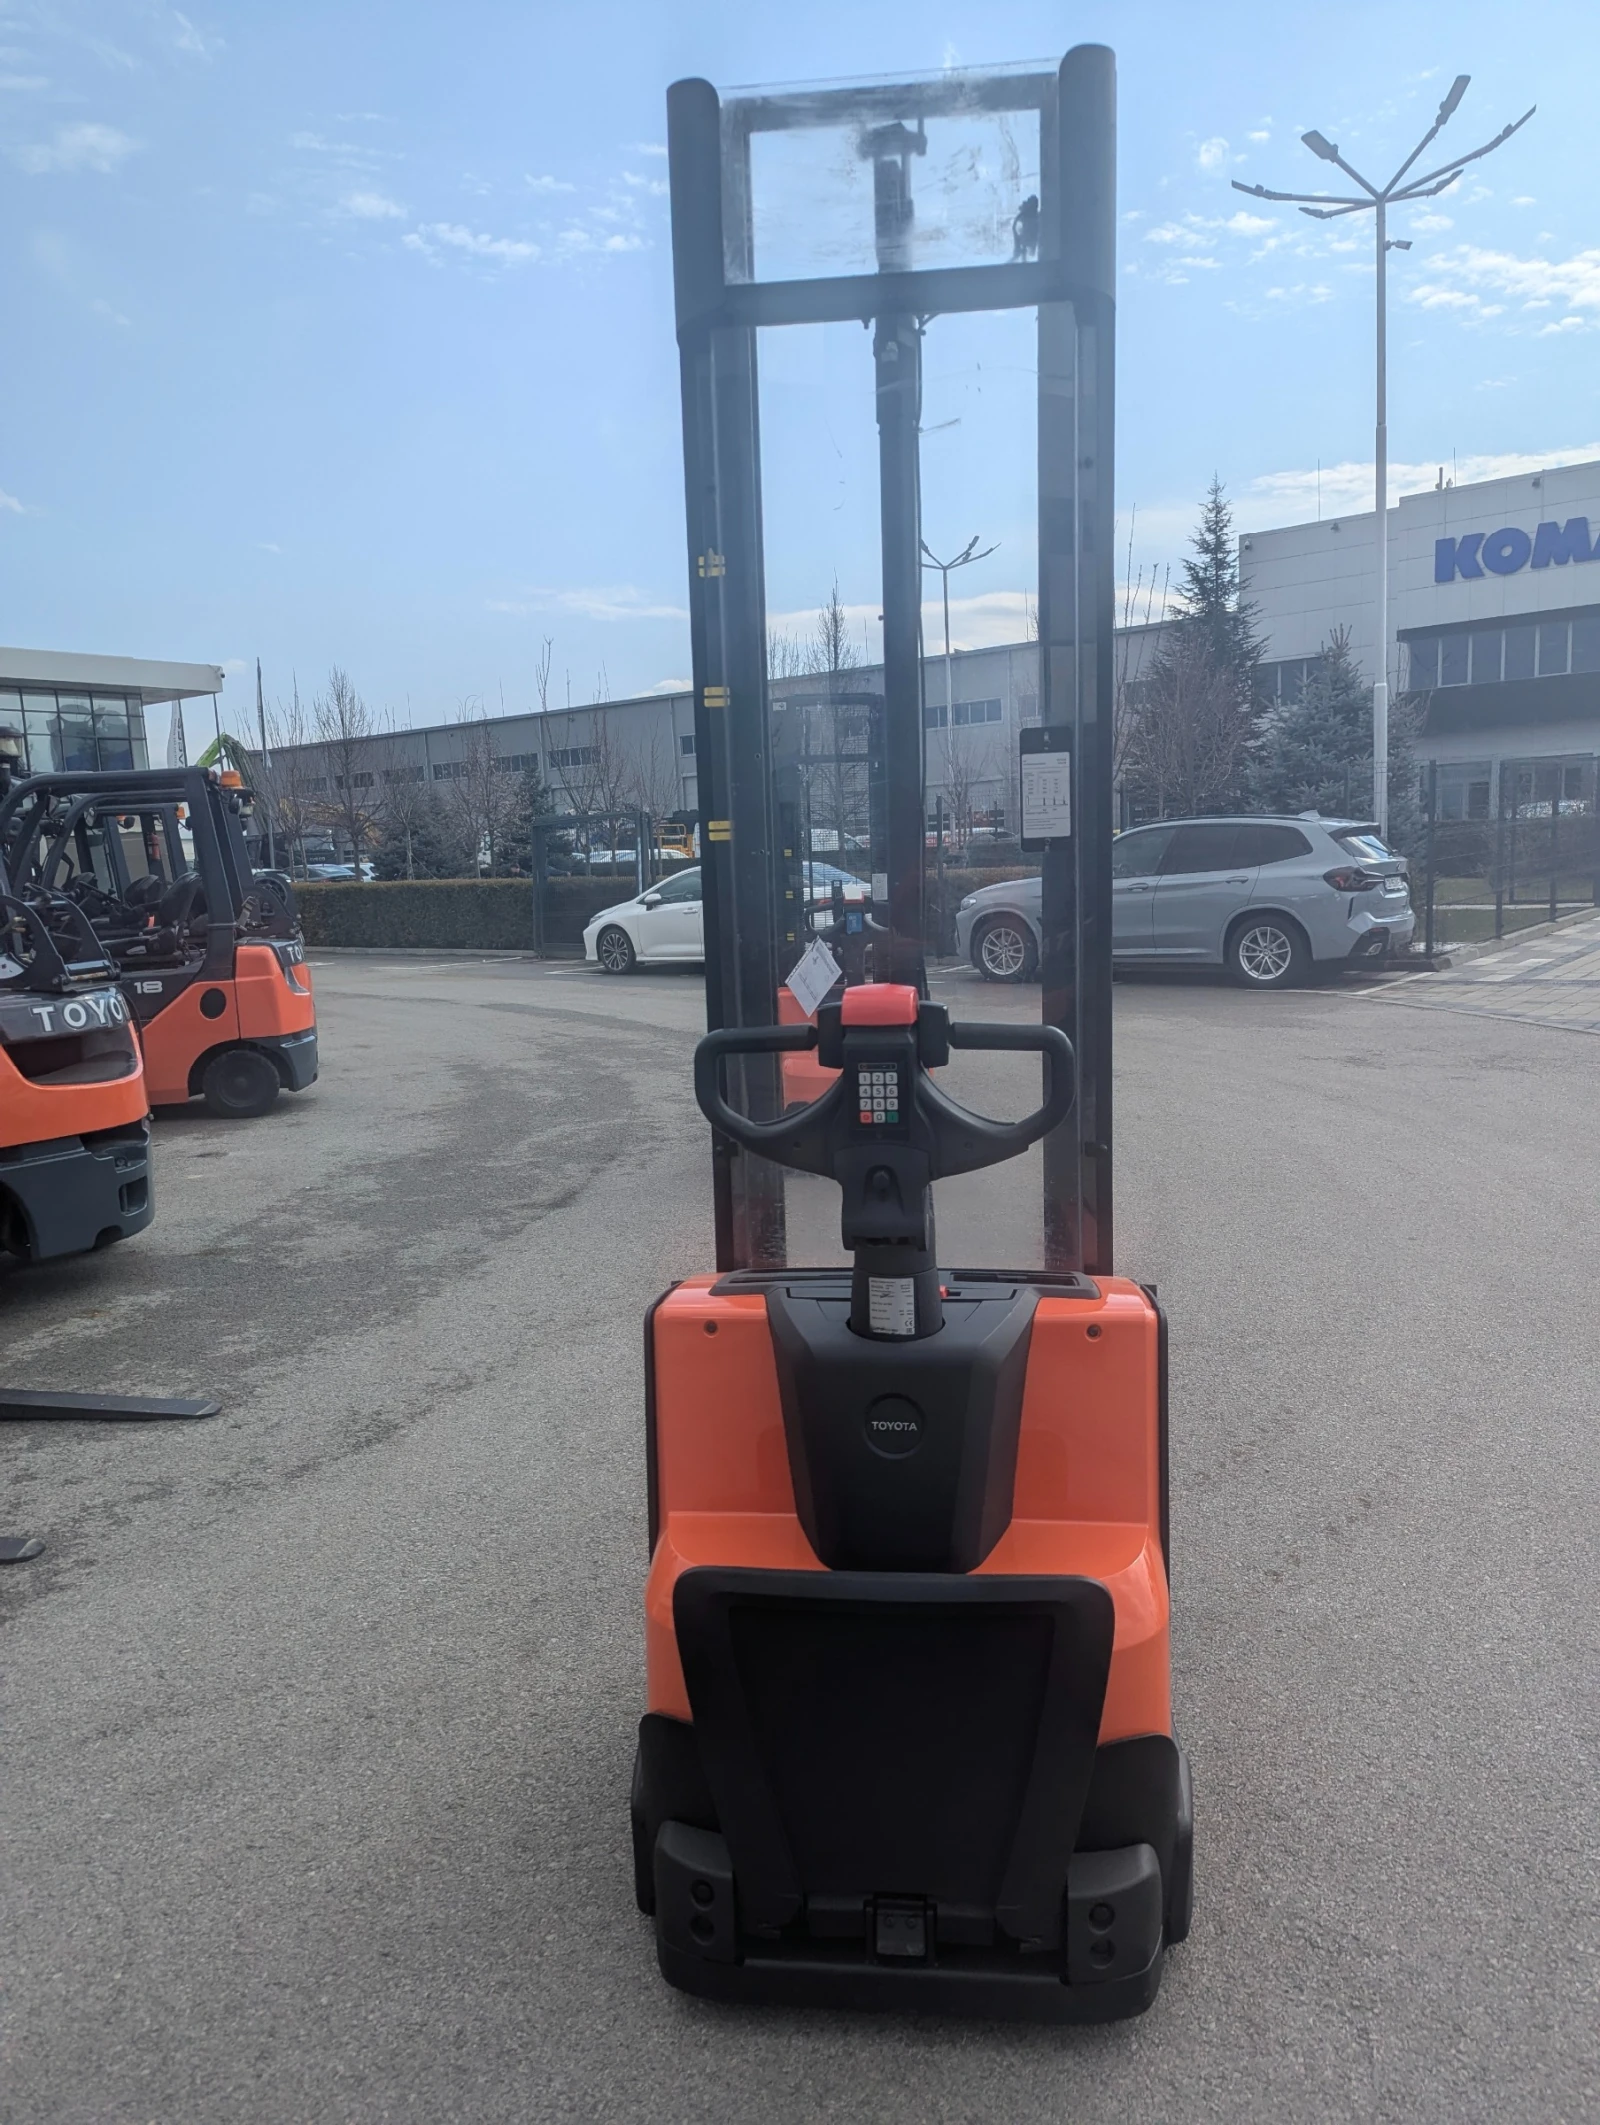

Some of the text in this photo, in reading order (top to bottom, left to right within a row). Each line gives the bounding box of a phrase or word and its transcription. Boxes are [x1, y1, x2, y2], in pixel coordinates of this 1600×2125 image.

[1434, 516, 1600, 583] KOM
[134, 981, 162, 994] 18
[876, 1113, 882, 1121] 0
[871, 1421, 918, 1431] TOYOTA
